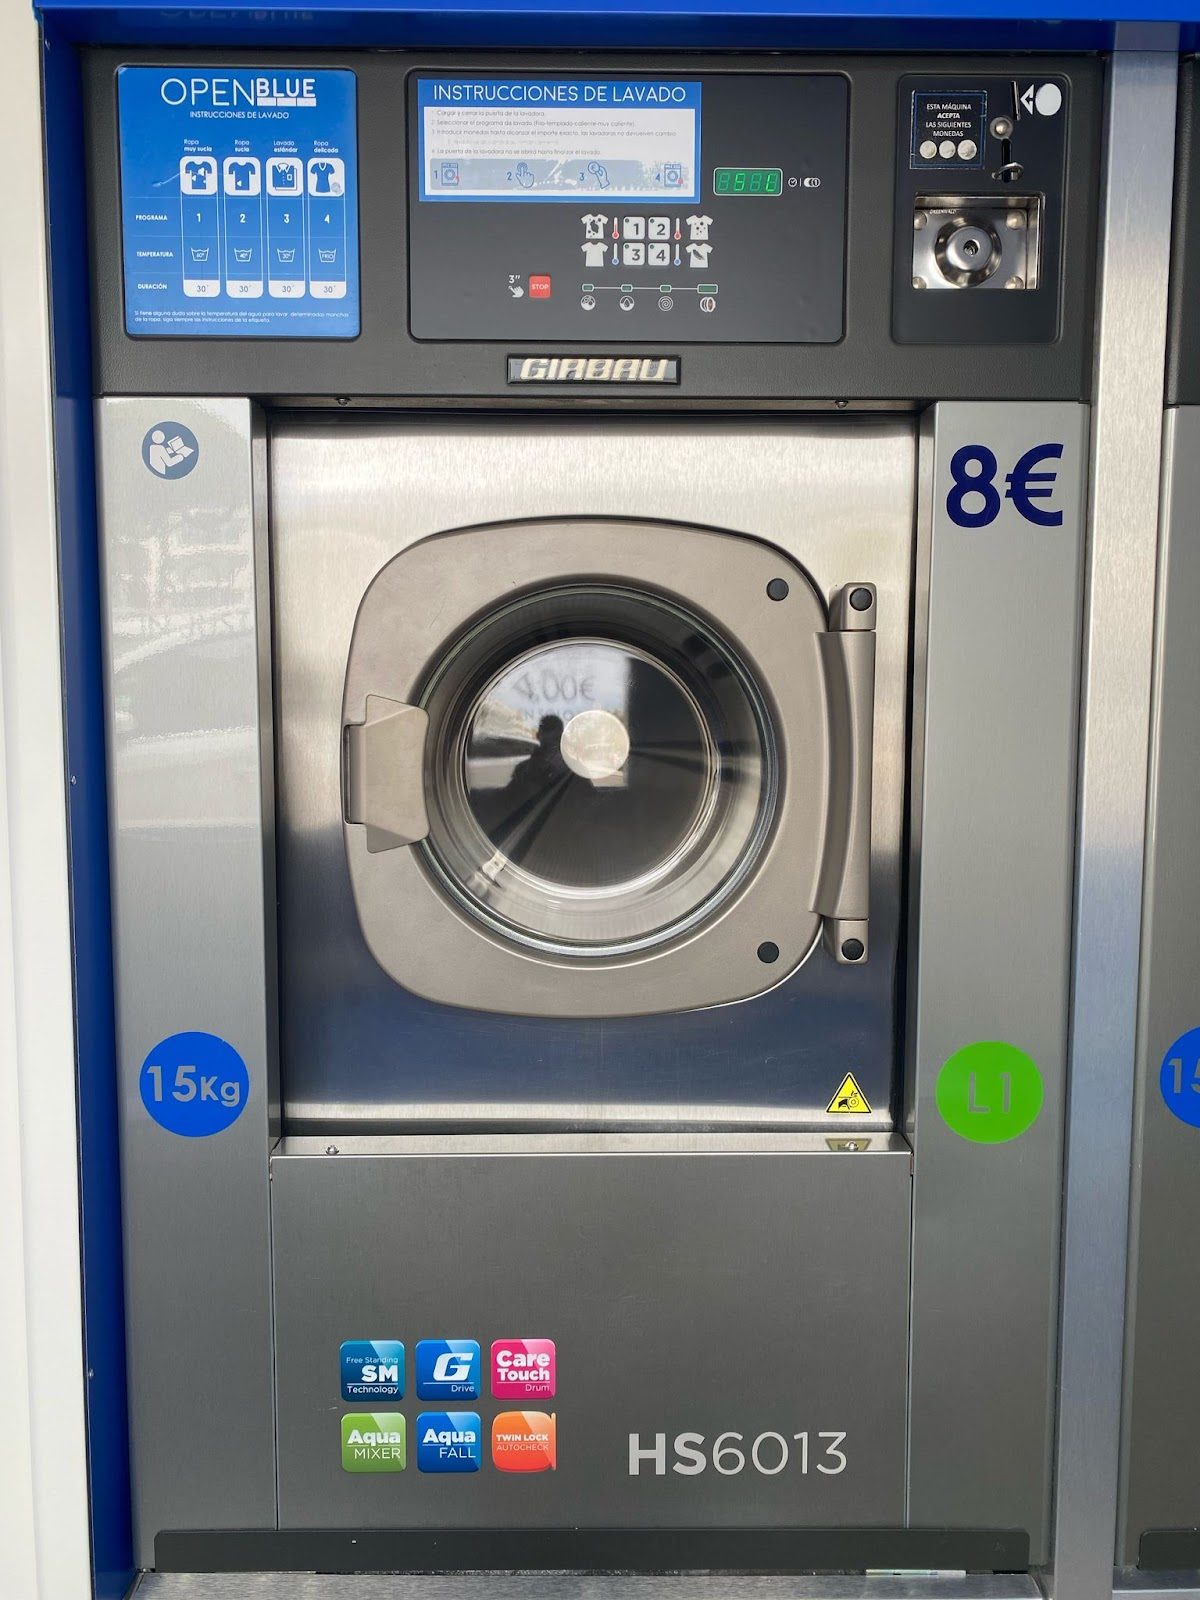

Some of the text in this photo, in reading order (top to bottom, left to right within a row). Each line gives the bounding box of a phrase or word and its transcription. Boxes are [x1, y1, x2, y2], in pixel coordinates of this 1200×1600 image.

[433, 85, 687, 102] INSTRUCCIONES DE LAVADO
[941, 102, 972, 110] MÁQUINA
[189, 111, 290, 120] INSTRUCCIONES DE LAVADO
[235, 139, 250, 147] Ropa
[313, 140, 329, 148] Ropa
[434, 171, 438, 180] 1
[506, 172, 512, 181] 2
[579, 172, 585, 181] 3
[655, 172, 661, 181] 4
[196, 213, 201, 222] 1
[240, 214, 246, 223] 2
[284, 214, 290, 224] 3
[324, 214, 330, 224] 4
[632, 223, 640, 235] 1
[656, 223, 666, 235] 2
[631, 249, 640, 261] 3
[656, 249, 666, 261] 4
[137, 282, 168, 290] DURACIÓN
[530, 283, 549, 291] STOP
[520, 358, 669, 380] GIRBAU
[946, 444, 1064, 528] 8€
[147, 1065, 240, 1108] 15Kg
[968, 1071, 1011, 1114] L1
[365, 1356, 398, 1365] Standing
[496, 1350, 550, 1368] Care
[433, 1352, 473, 1382] G
[361, 1365, 398, 1382] SM
[496, 1368, 550, 1382] Touch
[347, 1385, 398, 1394] Technology
[451, 1384, 475, 1393] Drive
[525, 1384, 550, 1392] Drum
[347, 1429, 400, 1446] Aqua
[422, 1428, 476, 1446] Aqua
[496, 1434, 548, 1442] TWIN LOCK
[354, 1448, 400, 1459] MIXER
[439, 1448, 476, 1459] FALL
[628, 1431, 847, 1476] HS6013
